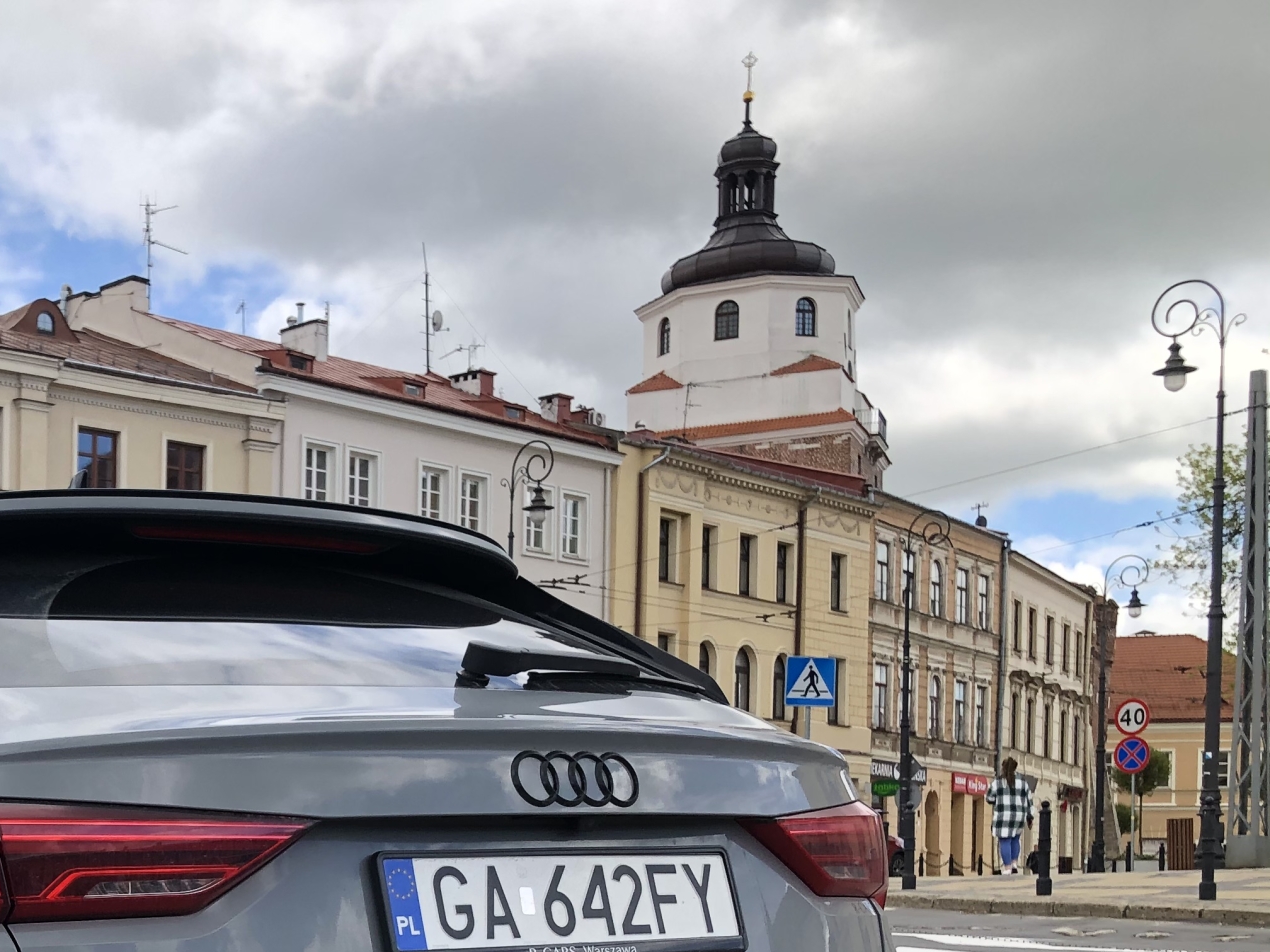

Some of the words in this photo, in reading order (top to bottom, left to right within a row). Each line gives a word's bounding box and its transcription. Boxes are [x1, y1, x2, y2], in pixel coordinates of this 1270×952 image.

[1120, 708, 1145, 726] 40
[433, 865, 521, 940] GA
[543, 863, 714, 937] 642FY
[396, 915, 421, 936] PL
